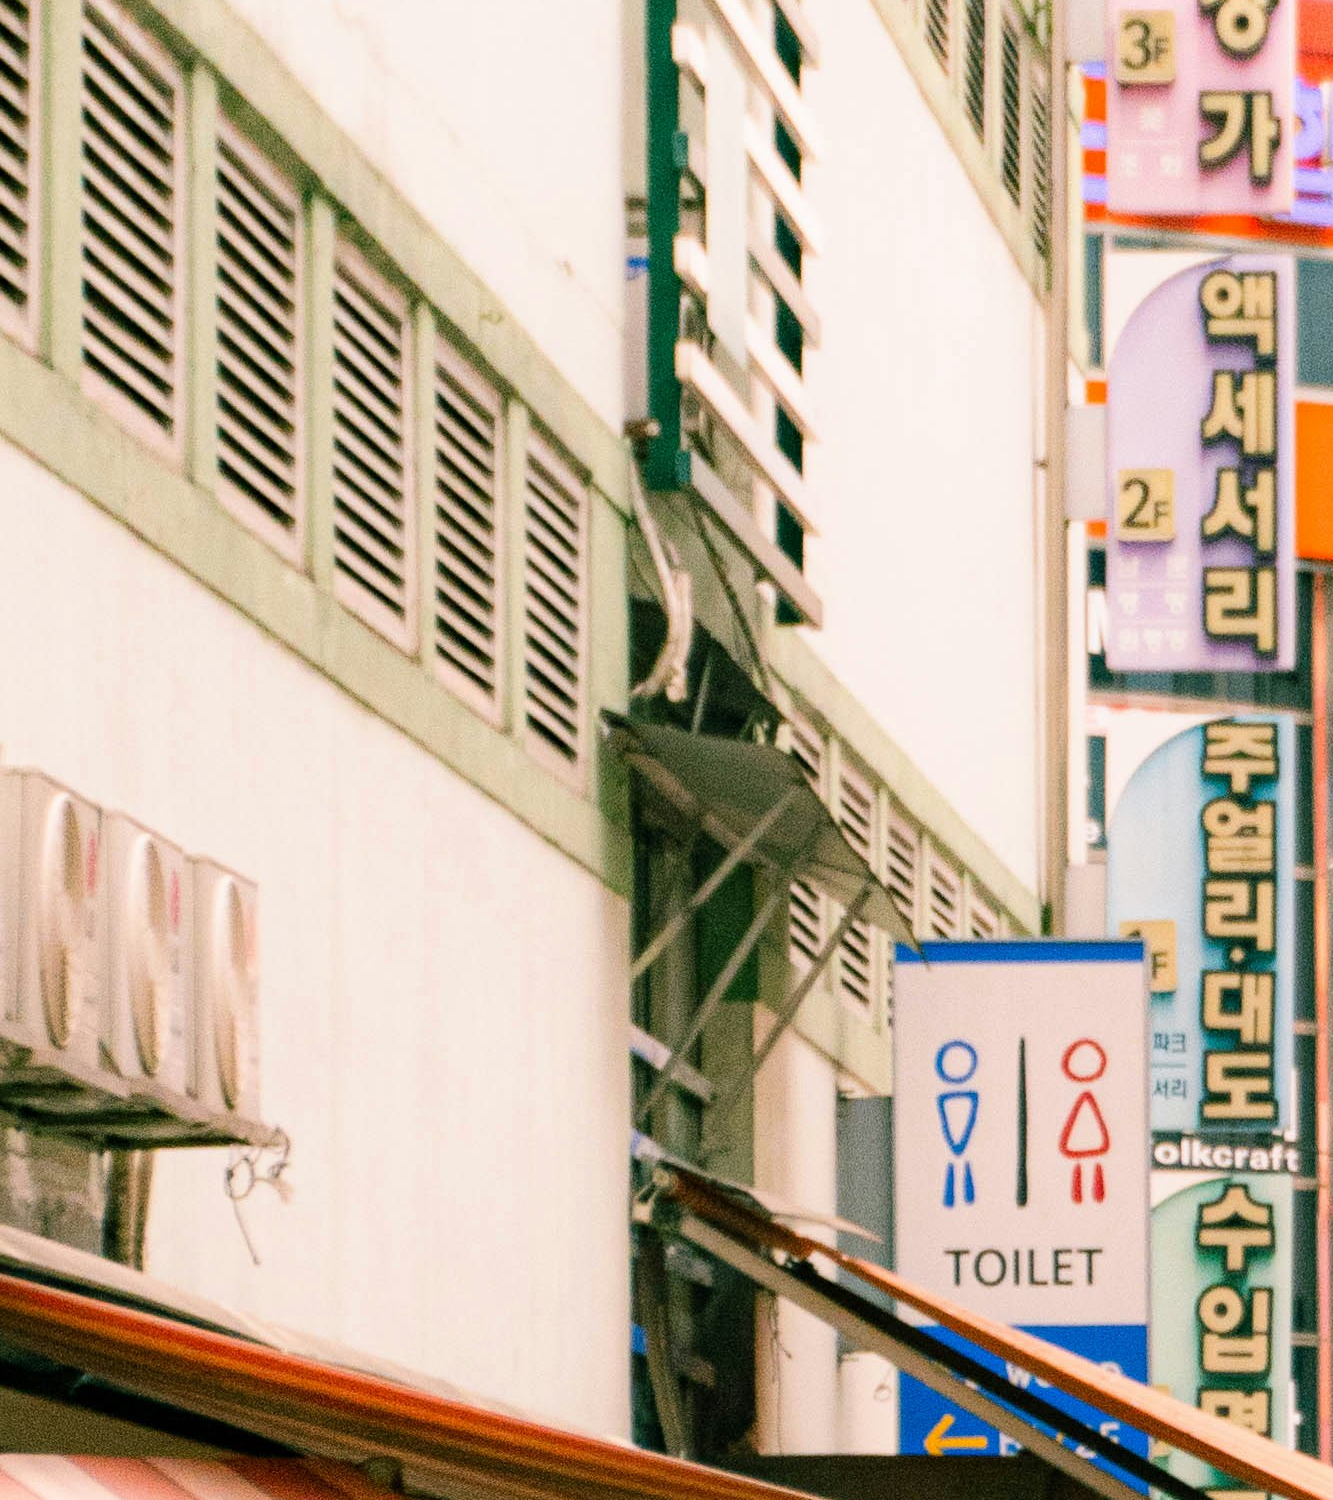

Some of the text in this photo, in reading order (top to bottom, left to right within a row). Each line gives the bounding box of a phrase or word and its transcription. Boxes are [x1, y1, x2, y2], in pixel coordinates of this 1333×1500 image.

[1122, 18, 1170, 71] 3F
[1200, 269, 1279, 660] 액세서리
[1122, 477, 1170, 529] 2F
[944, 1248, 1103, 1286] TOILET
